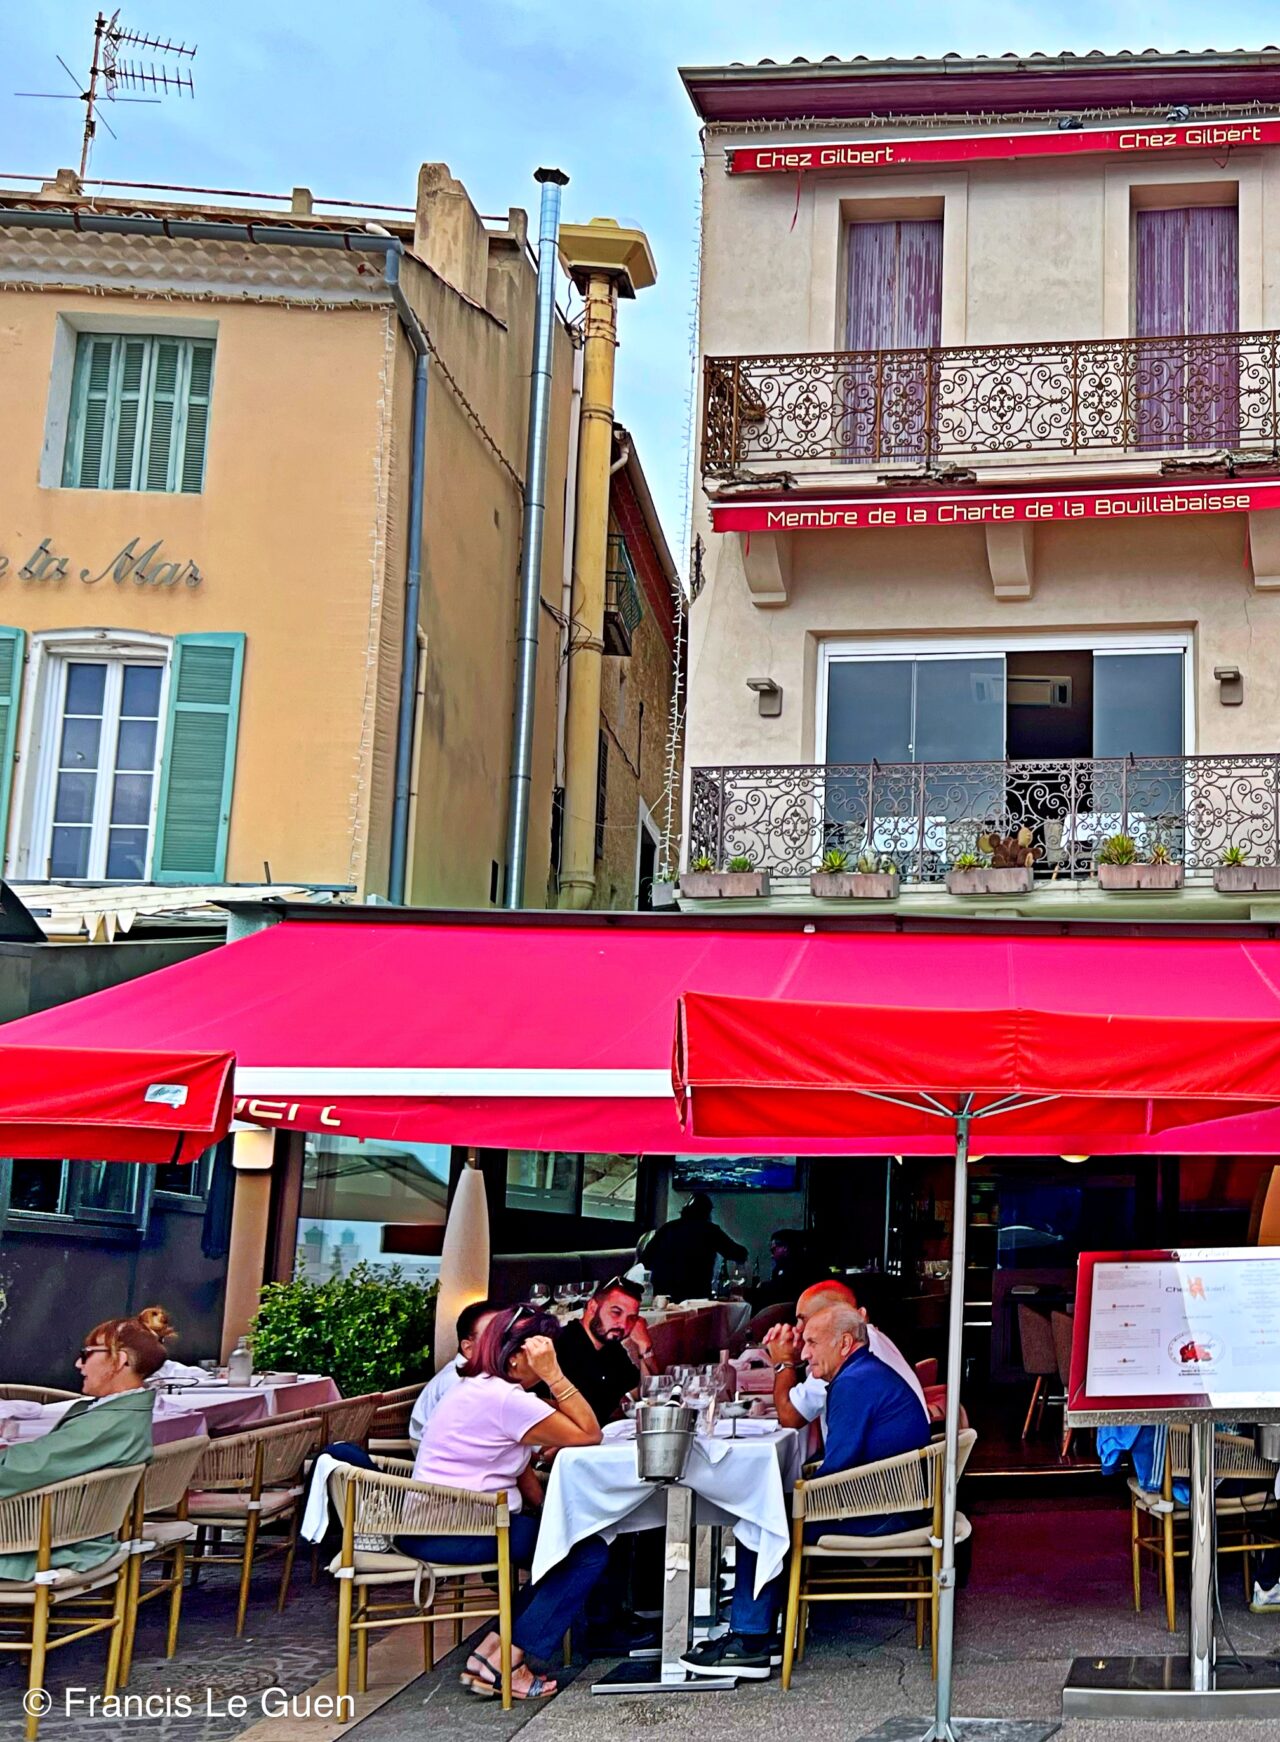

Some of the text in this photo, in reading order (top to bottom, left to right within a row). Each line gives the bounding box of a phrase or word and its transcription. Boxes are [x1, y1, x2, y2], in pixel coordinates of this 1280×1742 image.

[1119, 126, 1261, 149] Chez Gilbert
[756, 146, 894, 168] Chez Gilbert
[767, 509, 858, 528] Membre
[868, 507, 896, 524] de
[906, 506, 927, 522] la
[937, 502, 1015, 522] Charte
[1025, 501, 1053, 519] de
[1064, 500, 1085, 517] la
[18, 537, 70, 582] la
[79, 536, 204, 588] Mar
